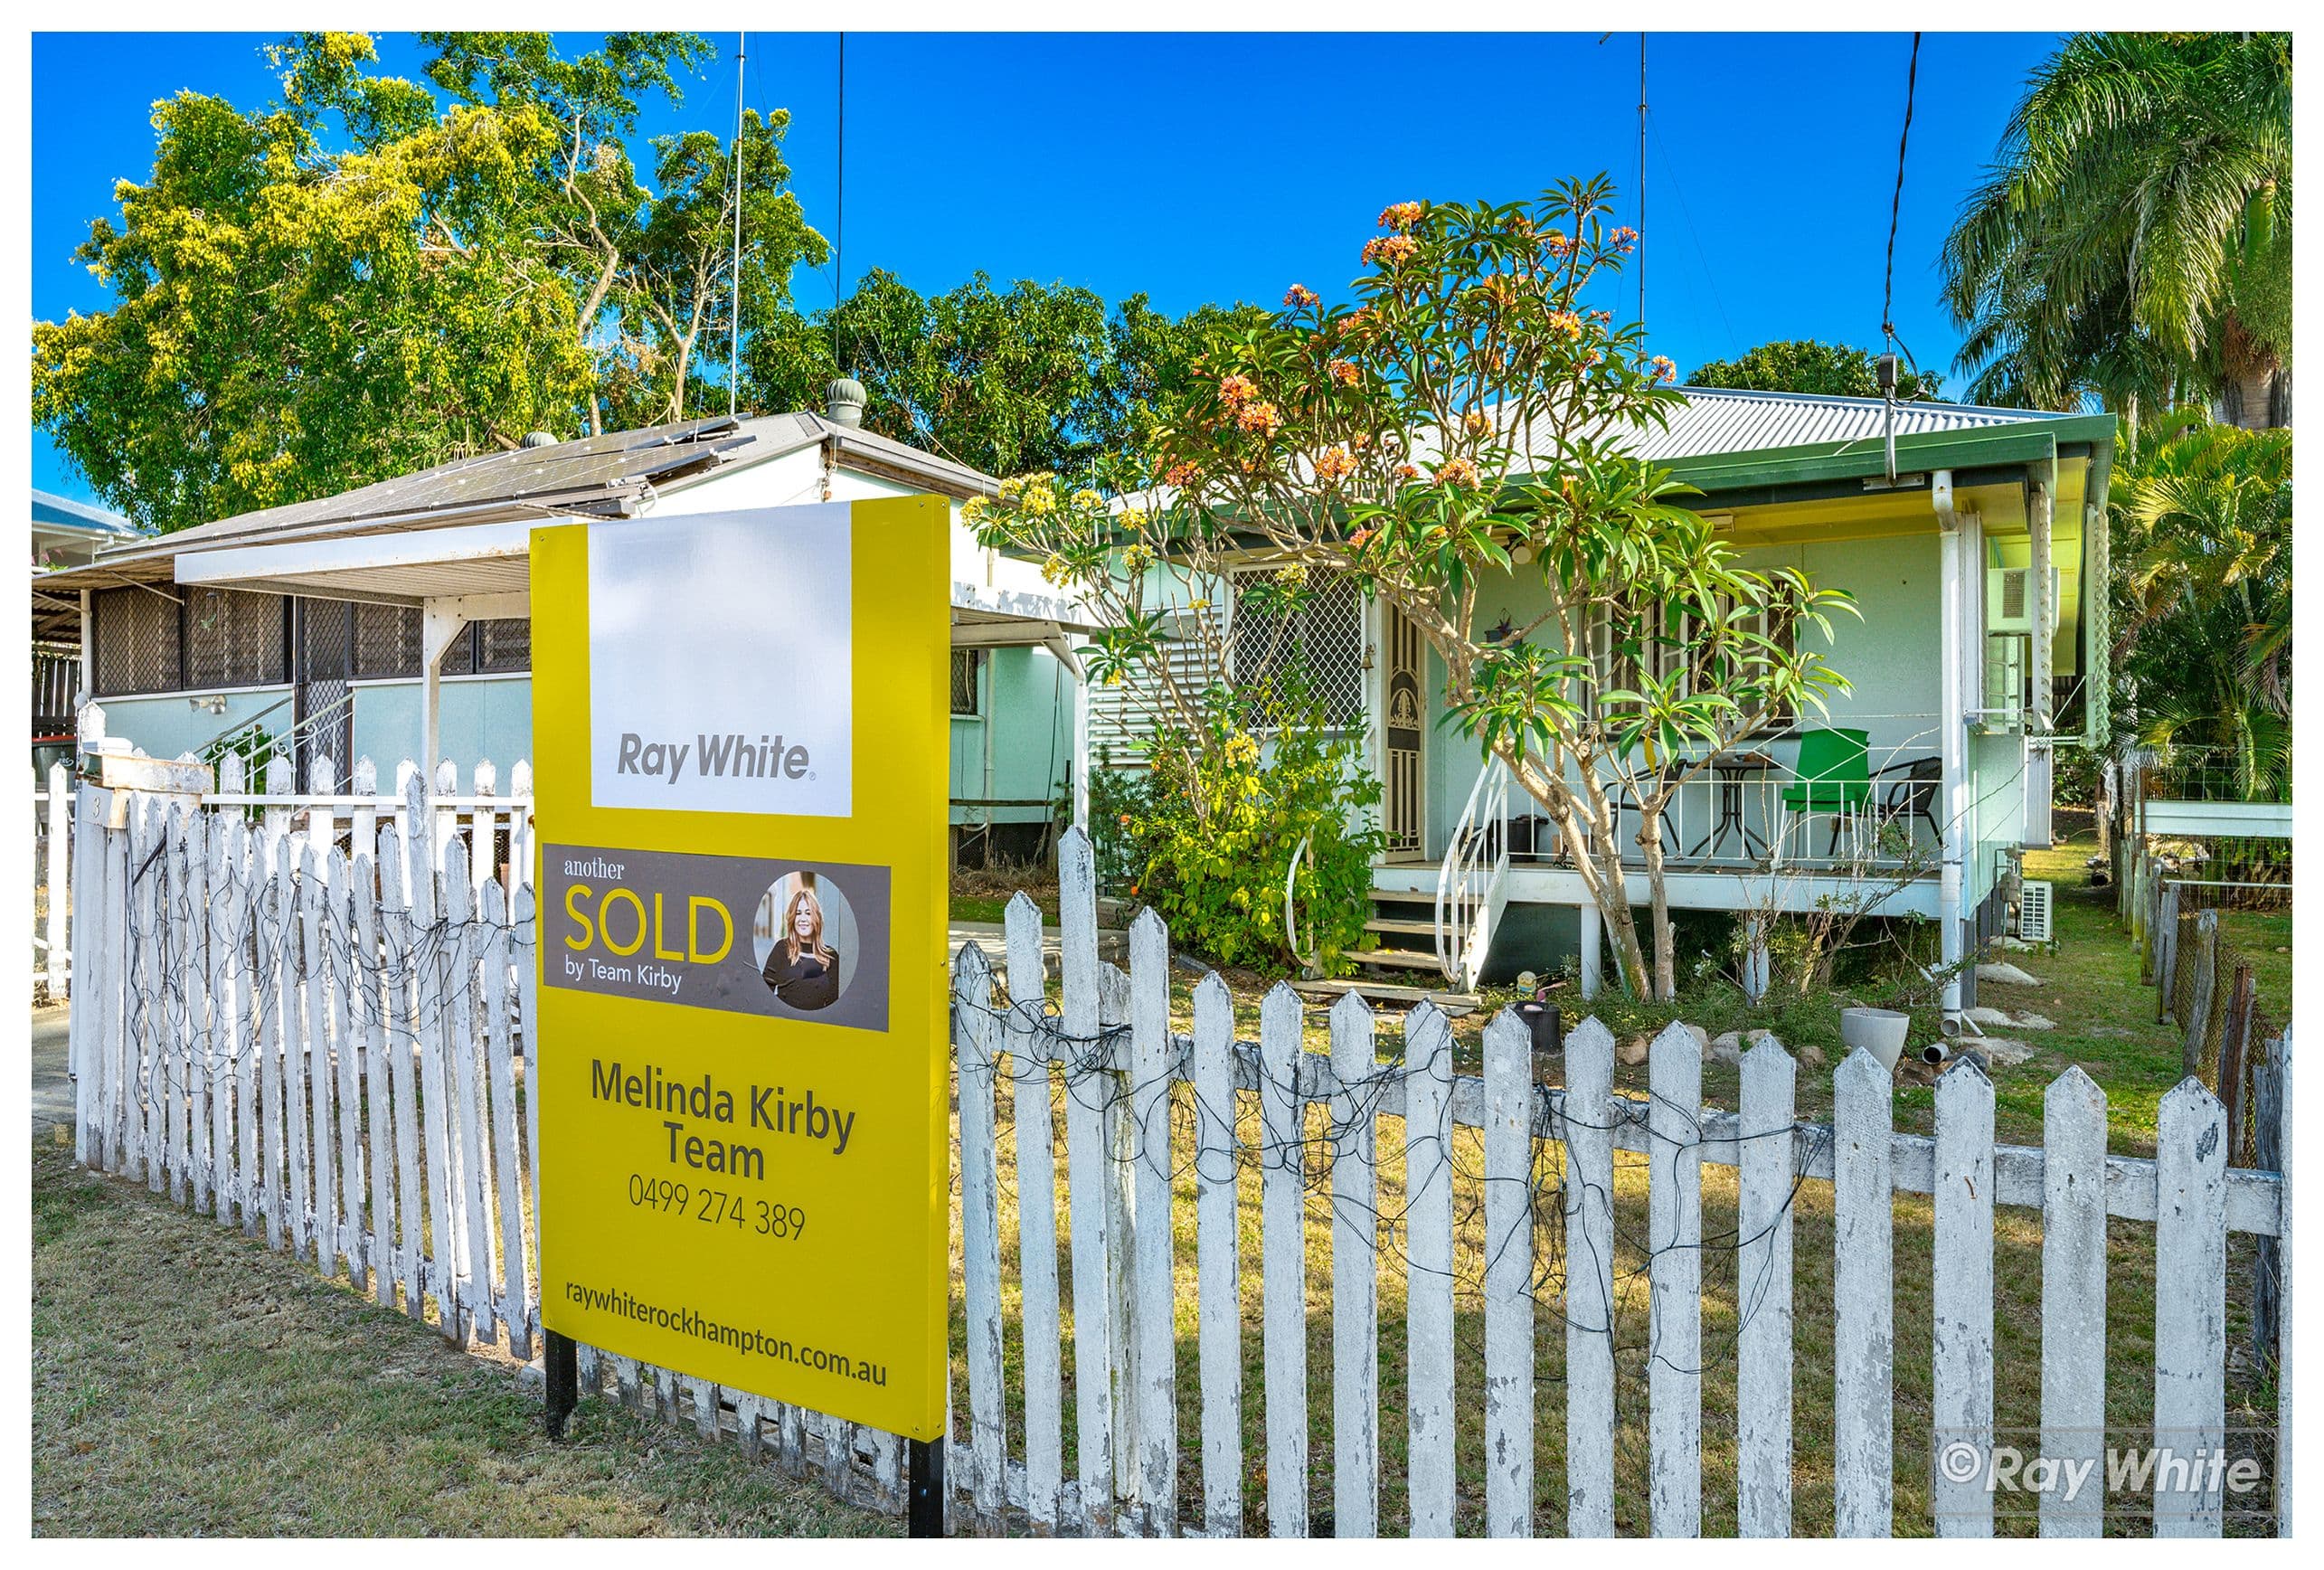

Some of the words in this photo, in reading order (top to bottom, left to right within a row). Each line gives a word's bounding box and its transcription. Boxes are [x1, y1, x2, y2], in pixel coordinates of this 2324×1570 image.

[618, 733, 690, 784] Ray
[93, 796, 100, 818] 3
[564, 856, 625, 880] another
[565, 884, 734, 965] SOLD
[565, 954, 584, 978] by
[589, 958, 631, 983] Team
[638, 965, 682, 995] Kirby
[591, 1058, 733, 1123] Melinda
[751, 1084, 855, 1155] Kirby
[663, 1121, 764, 1180] Team
[629, 1173, 689, 1215] 0499
[697, 1188, 745, 1230] 274
[755, 1200, 806, 1241] 389
[565, 1281, 886, 1386] raywhiterockhampton.com.au
